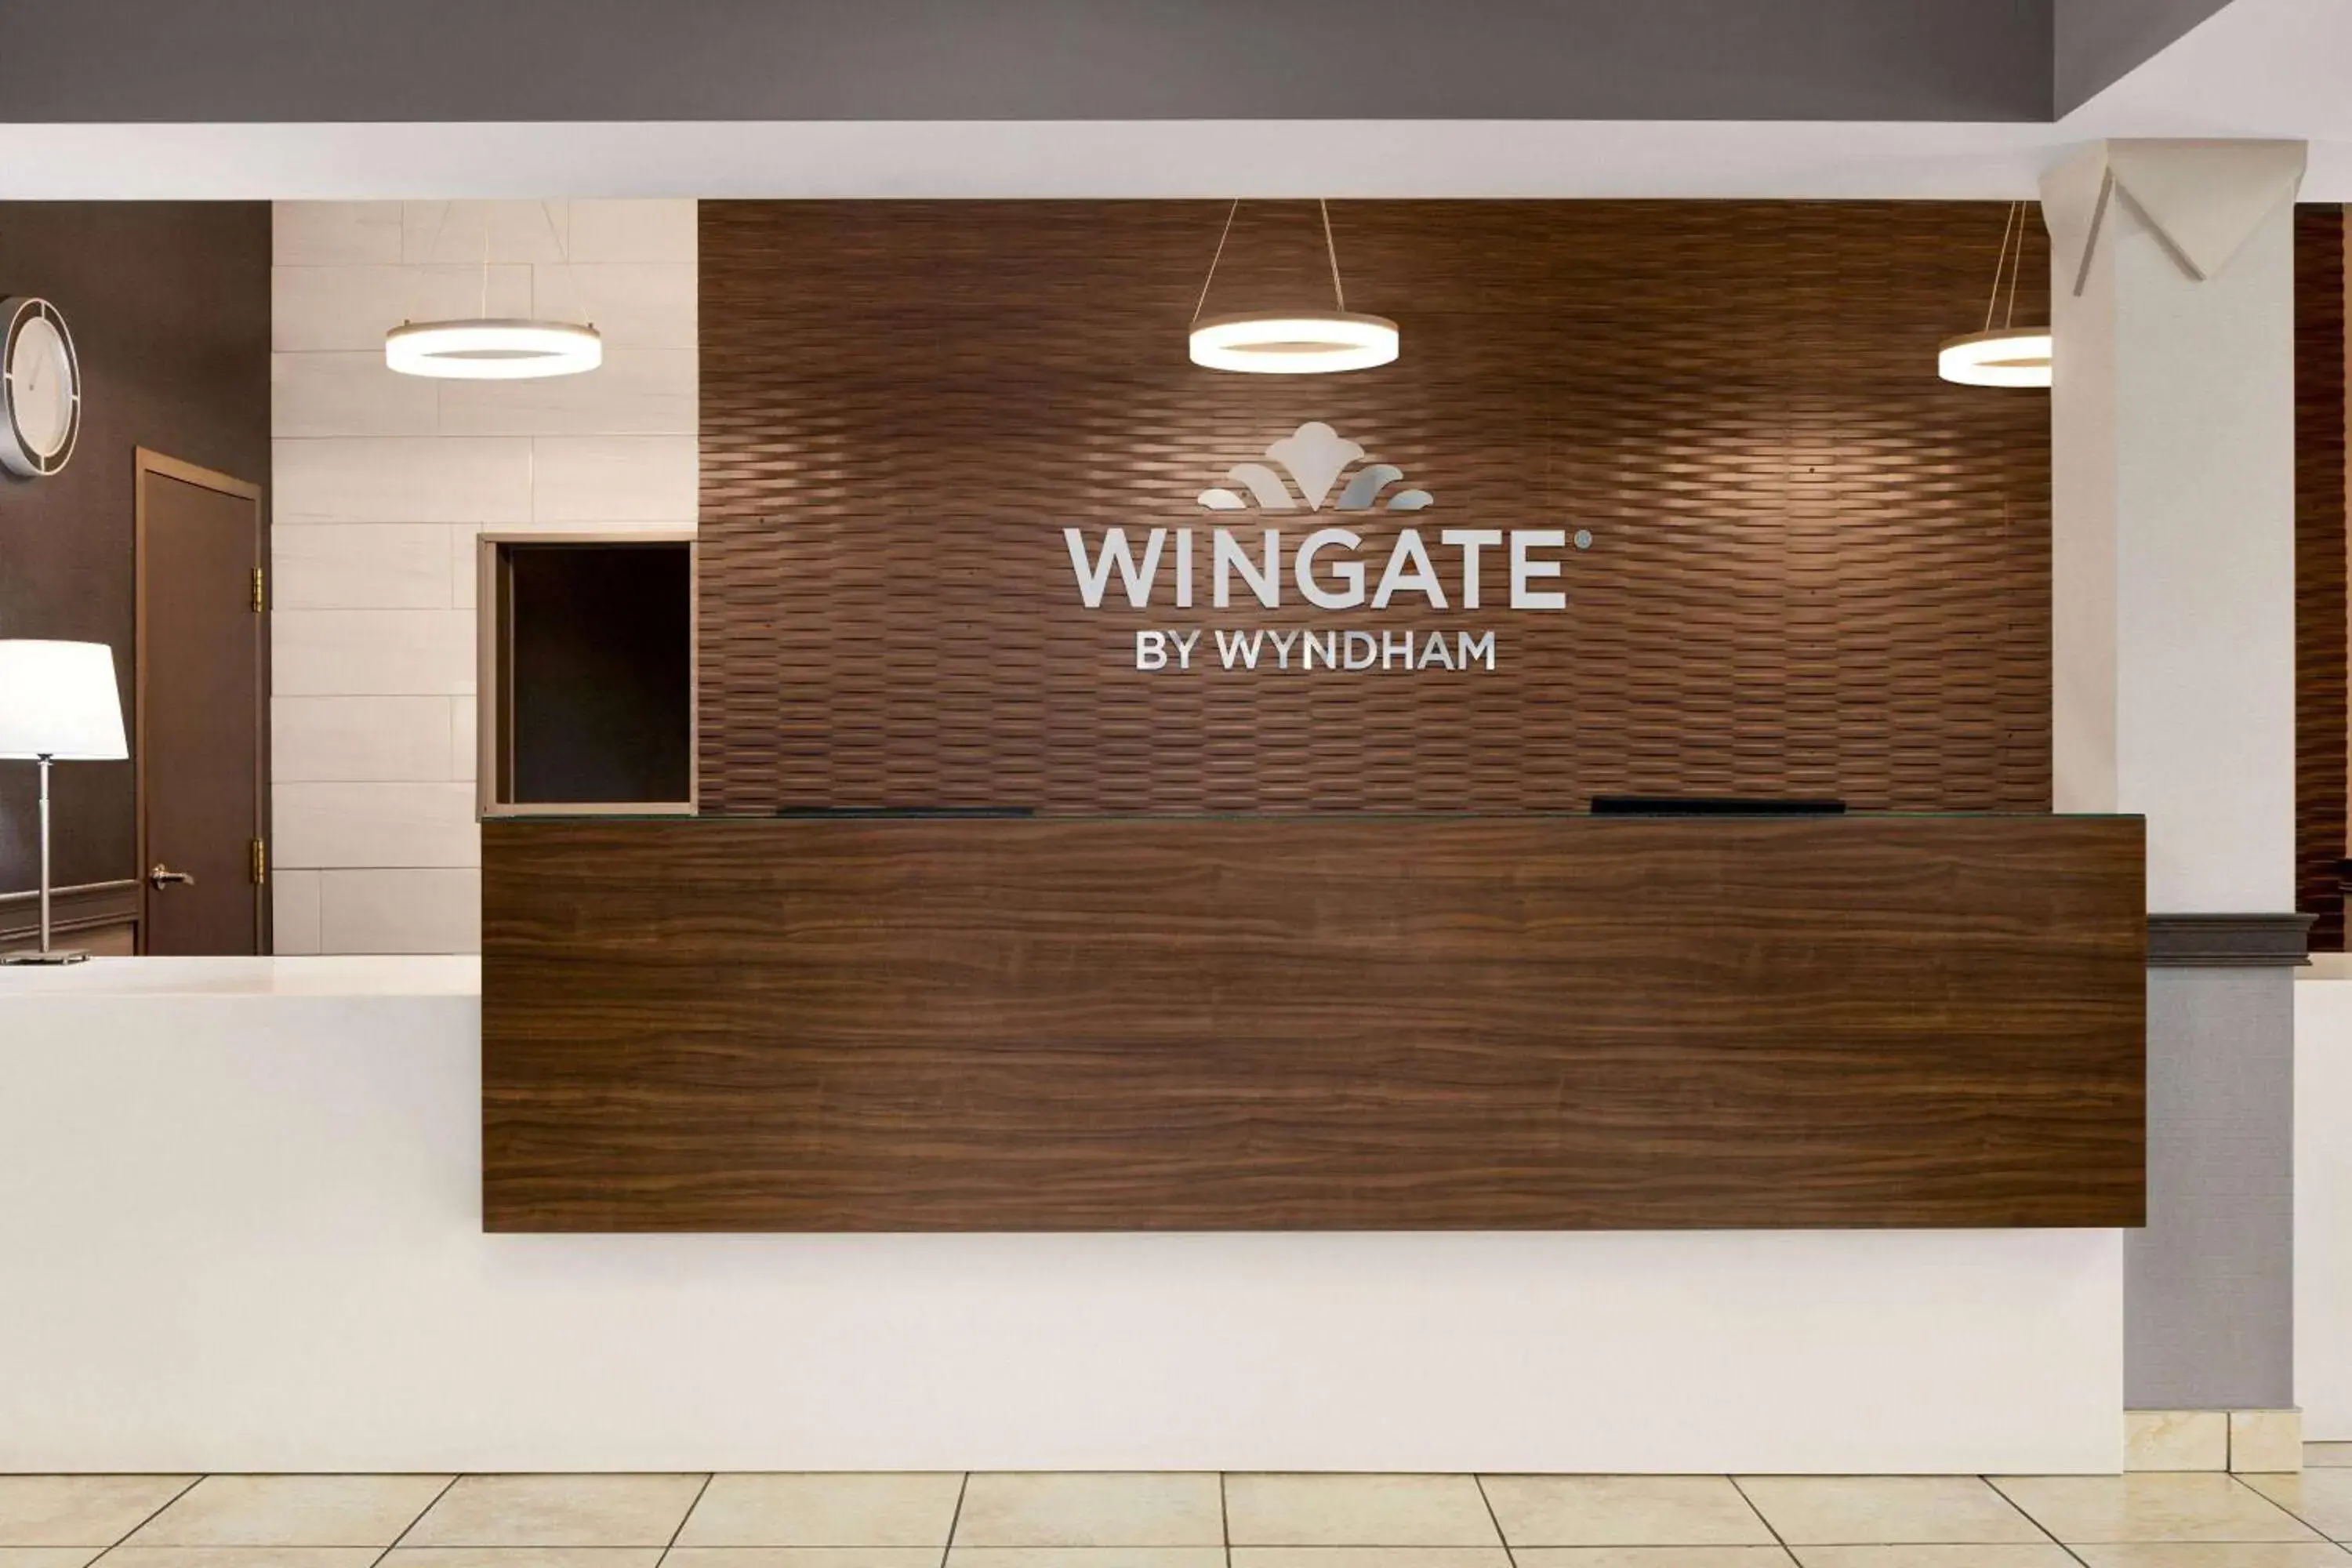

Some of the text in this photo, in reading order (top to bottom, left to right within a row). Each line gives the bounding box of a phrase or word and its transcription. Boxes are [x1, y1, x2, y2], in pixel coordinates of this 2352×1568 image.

[1063, 528, 1566, 609] WINGATE
[1135, 630, 1496, 671] BY WYNDHAM
